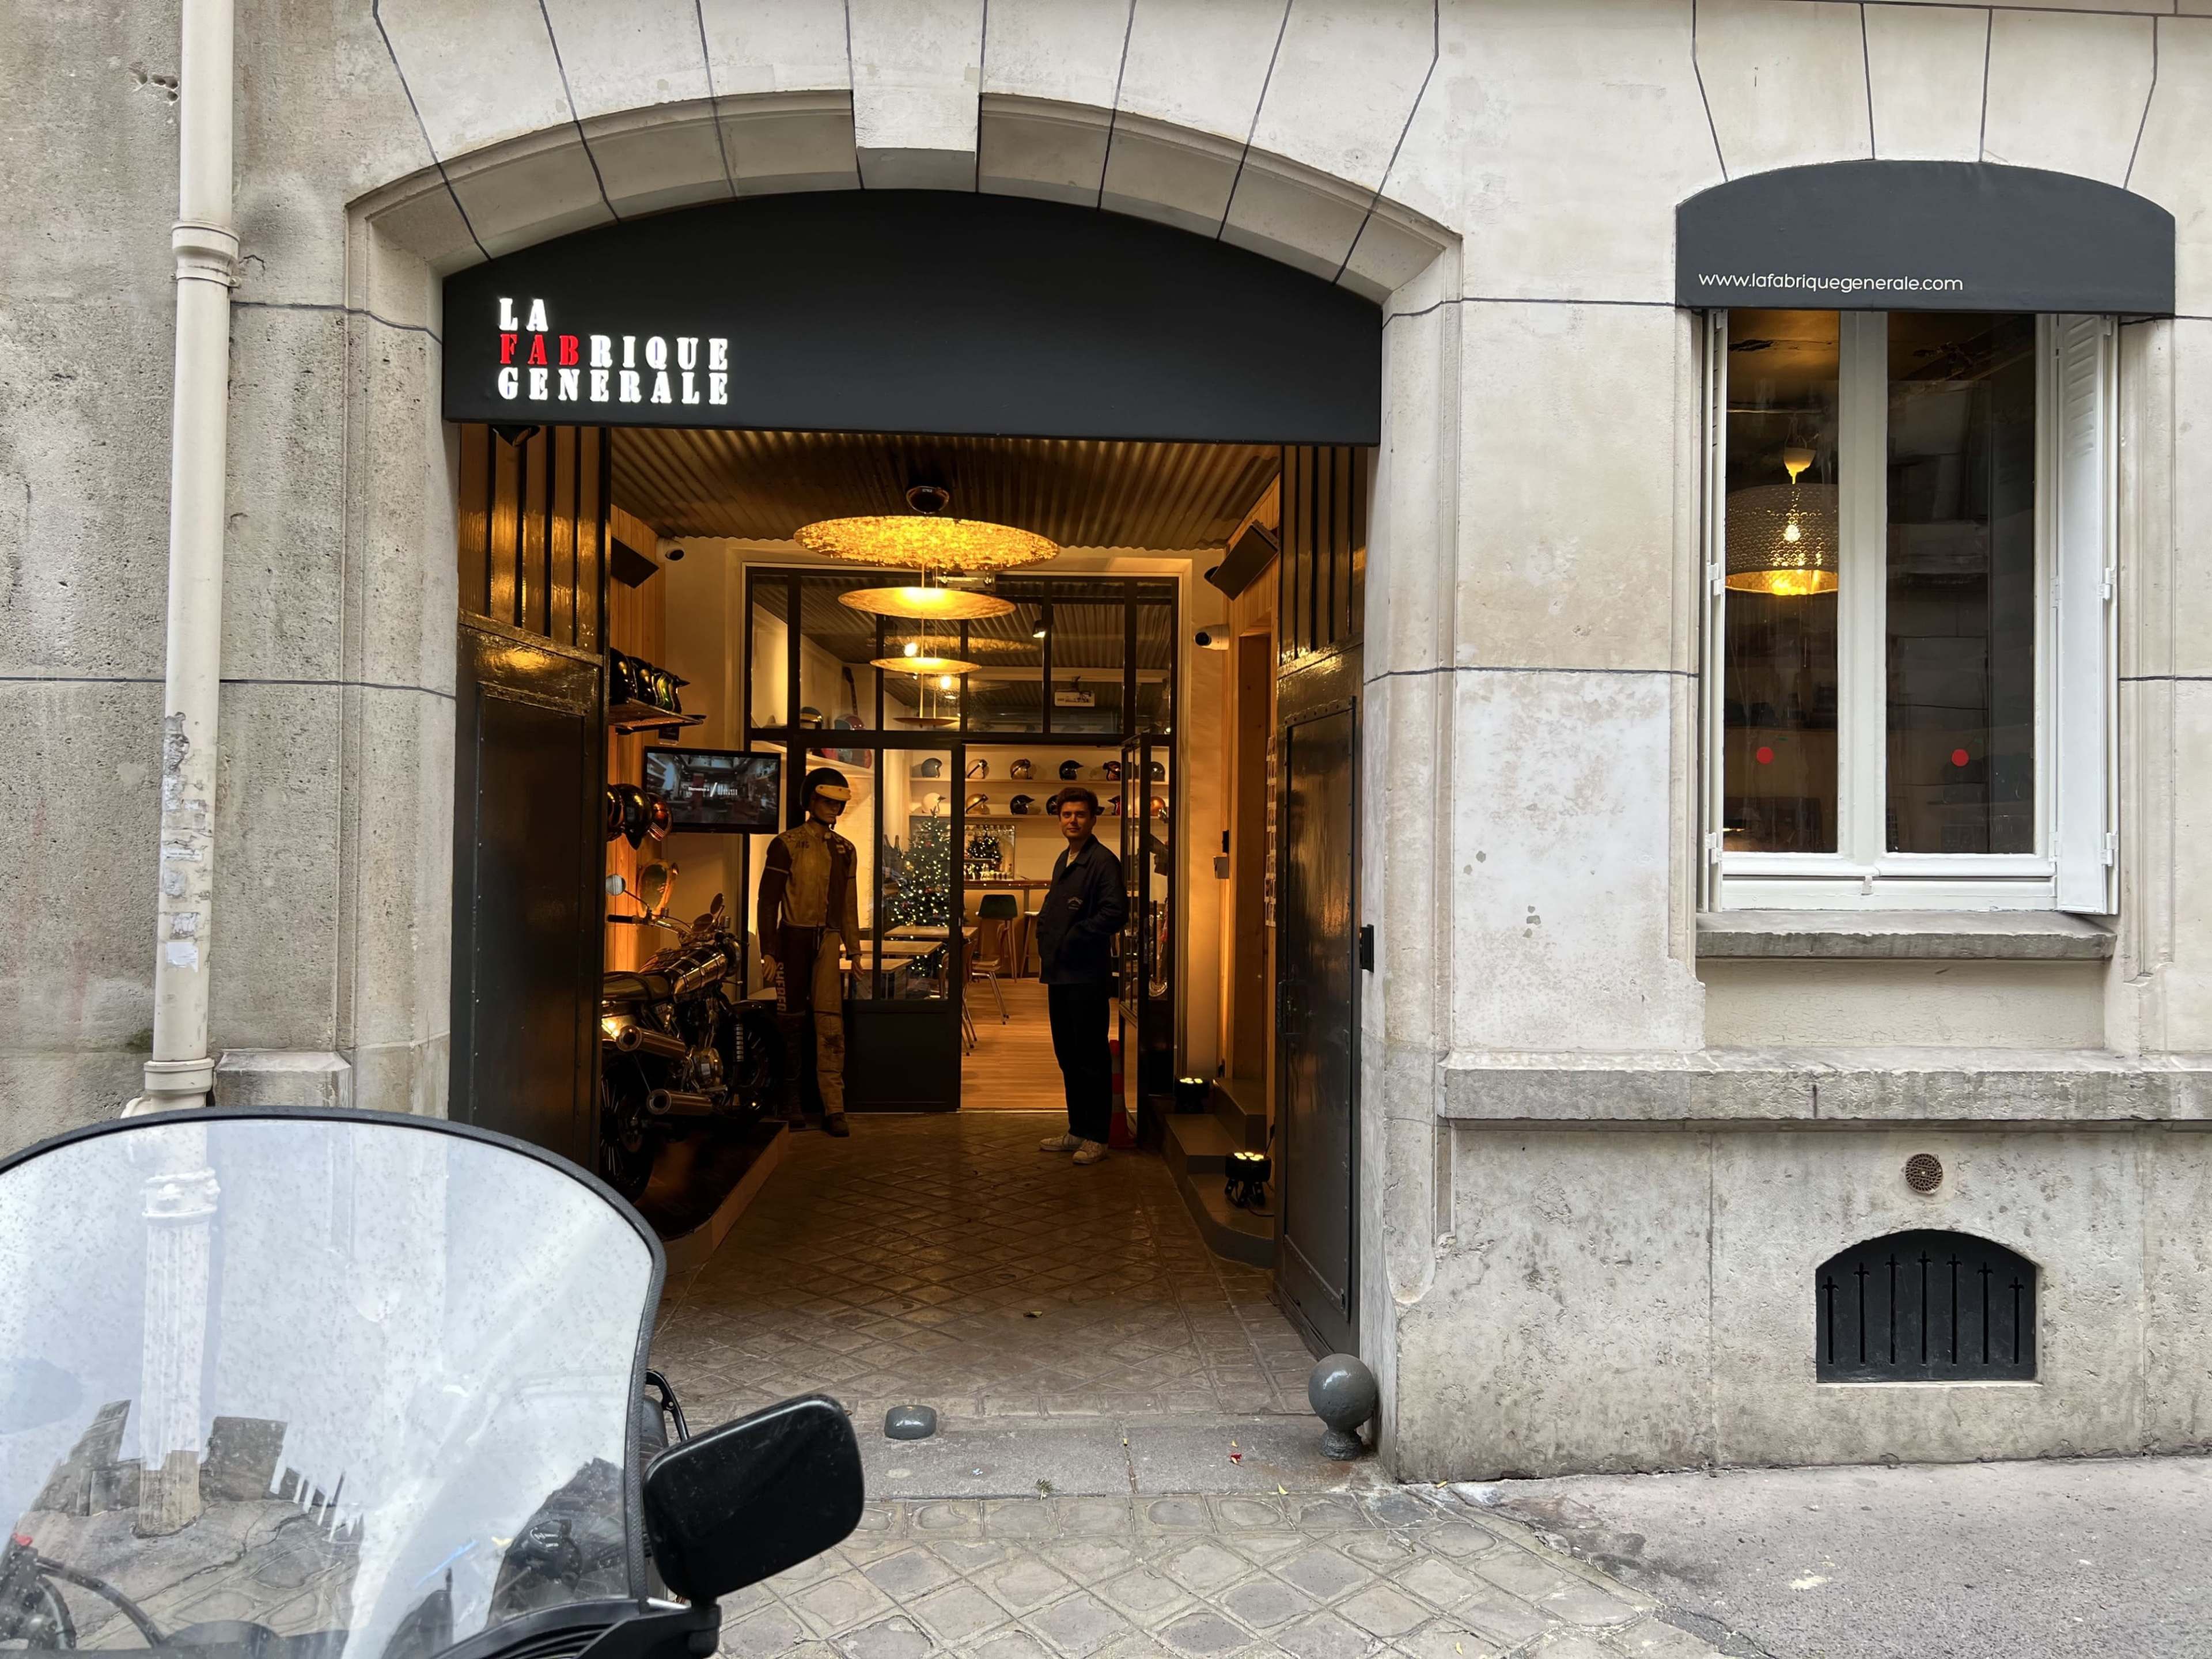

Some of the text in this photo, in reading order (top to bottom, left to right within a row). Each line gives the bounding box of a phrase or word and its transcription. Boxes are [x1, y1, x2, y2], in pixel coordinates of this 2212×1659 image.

[1699, 273, 1963, 293] www.lafabriquegenerale.com
[498, 297, 548, 331] LA
[500, 334, 728, 370] FABRIQUE
[498, 368, 728, 404] GENERALE
